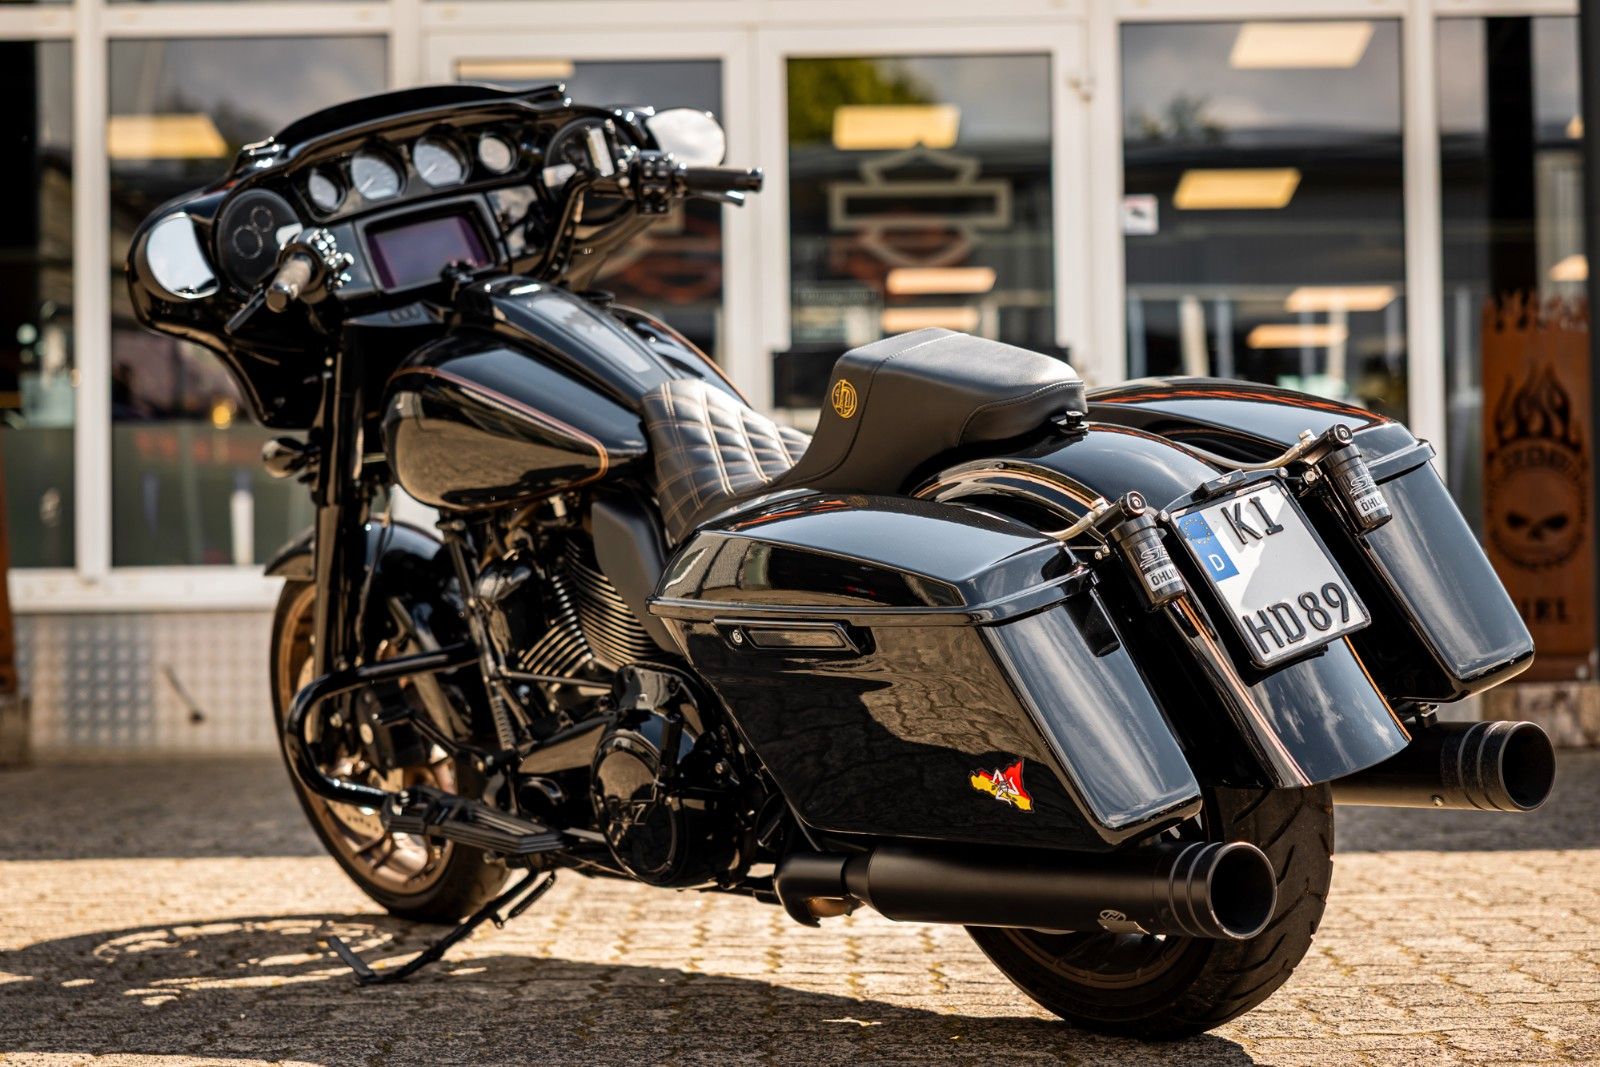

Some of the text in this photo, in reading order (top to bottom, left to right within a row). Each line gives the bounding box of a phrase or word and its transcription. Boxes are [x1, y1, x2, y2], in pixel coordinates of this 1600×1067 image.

[1220, 496, 1284, 545] KI
[1211, 553, 1225, 572] D
[1150, 568, 1178, 586] ÖHLI
